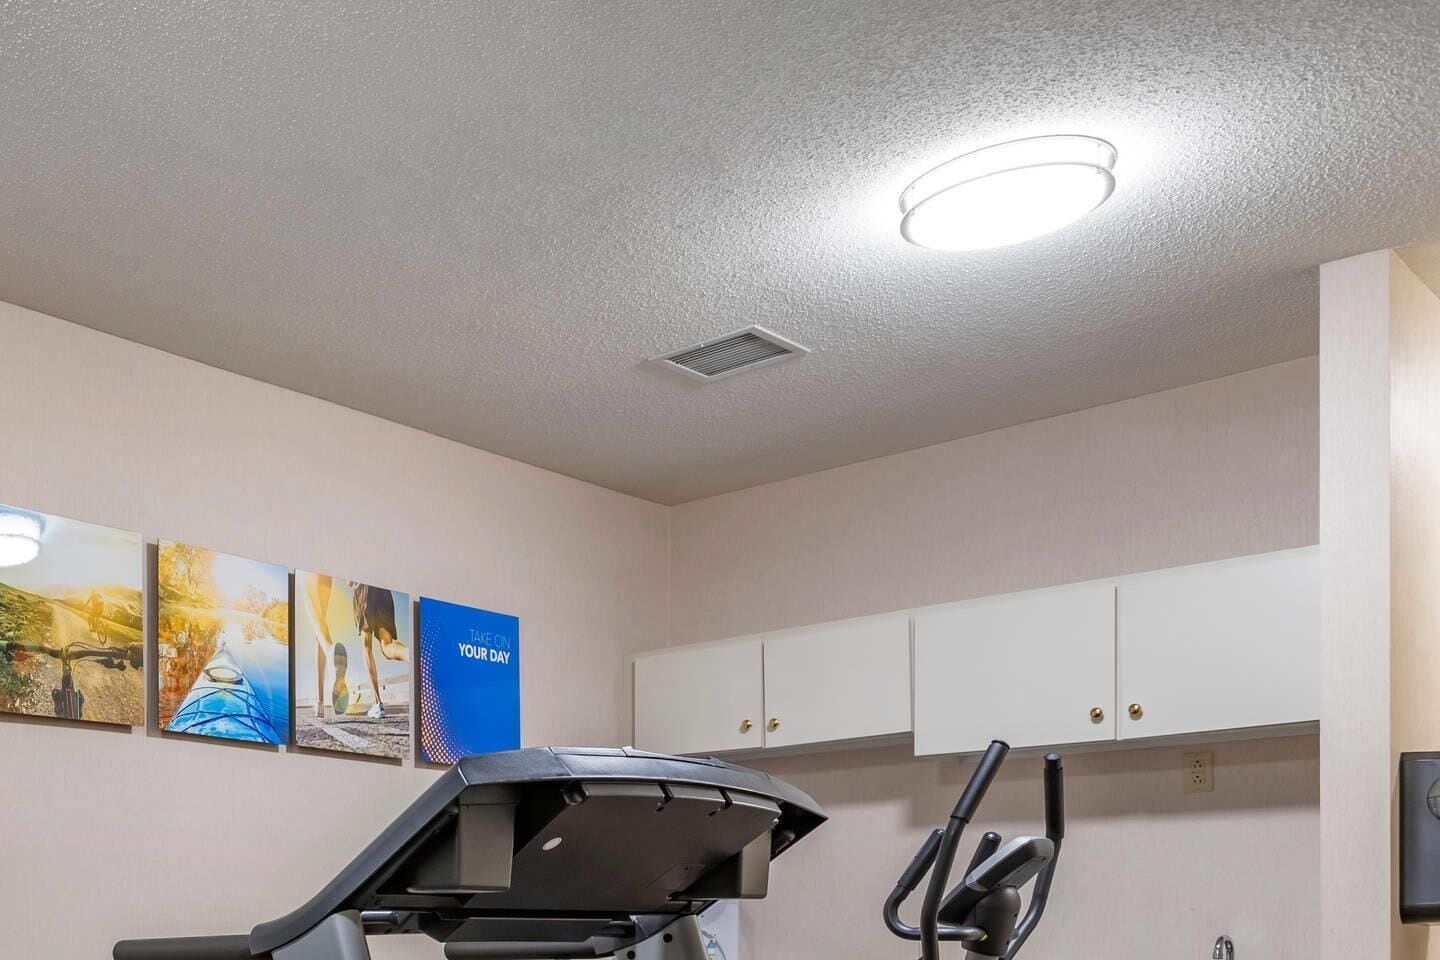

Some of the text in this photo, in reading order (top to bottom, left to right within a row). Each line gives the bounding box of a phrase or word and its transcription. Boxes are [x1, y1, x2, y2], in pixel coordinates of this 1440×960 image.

[468, 628, 511, 649] TAKE ON
[458, 642, 511, 665] YOUR DAY
